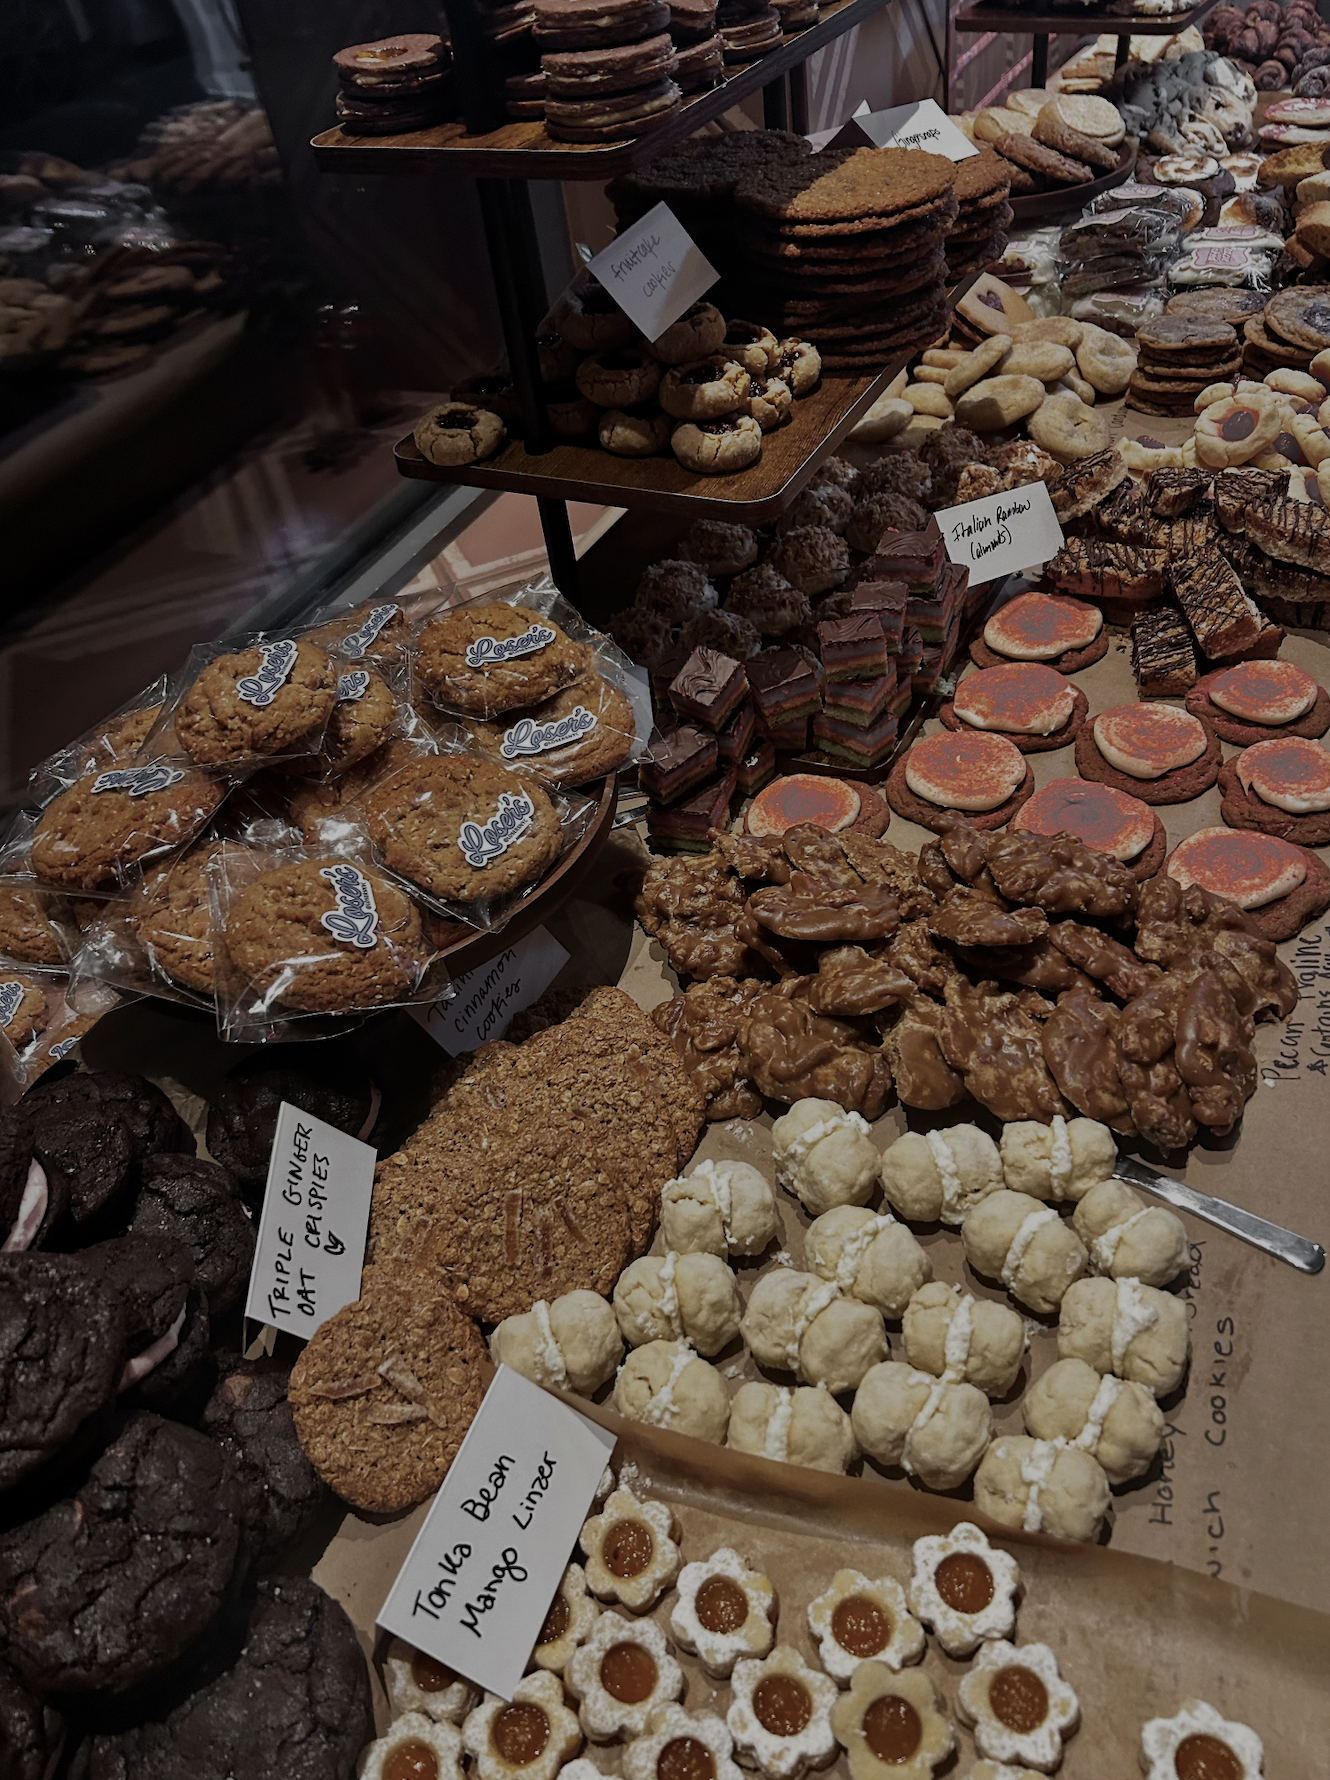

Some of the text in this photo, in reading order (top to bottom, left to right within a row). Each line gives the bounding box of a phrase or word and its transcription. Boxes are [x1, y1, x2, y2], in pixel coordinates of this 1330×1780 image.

[611, 235, 661, 282] fruitcake
[643, 261, 676, 297] cookies
[952, 515, 992, 542] Italian
[343, 604, 396, 657] Loser's
[469, 626, 552, 665] Loser's
[240, 640, 293, 703] Loser's
[503, 708, 594, 755] Loser's
[461, 796, 531, 864] Loser's
[323, 866, 375, 945] Loser's
[454, 949, 517, 1033] cinnamon
[477, 978, 521, 1041] cookies
[1261, 1022, 1305, 1080] Pecan
[268, 1122, 313, 1319] TRIPLE GINGER
[297, 1153, 330, 1316] OAT CRISPIES
[1205, 1316, 1235, 1447] Cookies
[1149, 1423, 1187, 1525] Honey
[413, 1455, 516, 1619] Tonka Bean
[460, 1451, 557, 1638] Mango Linzer
